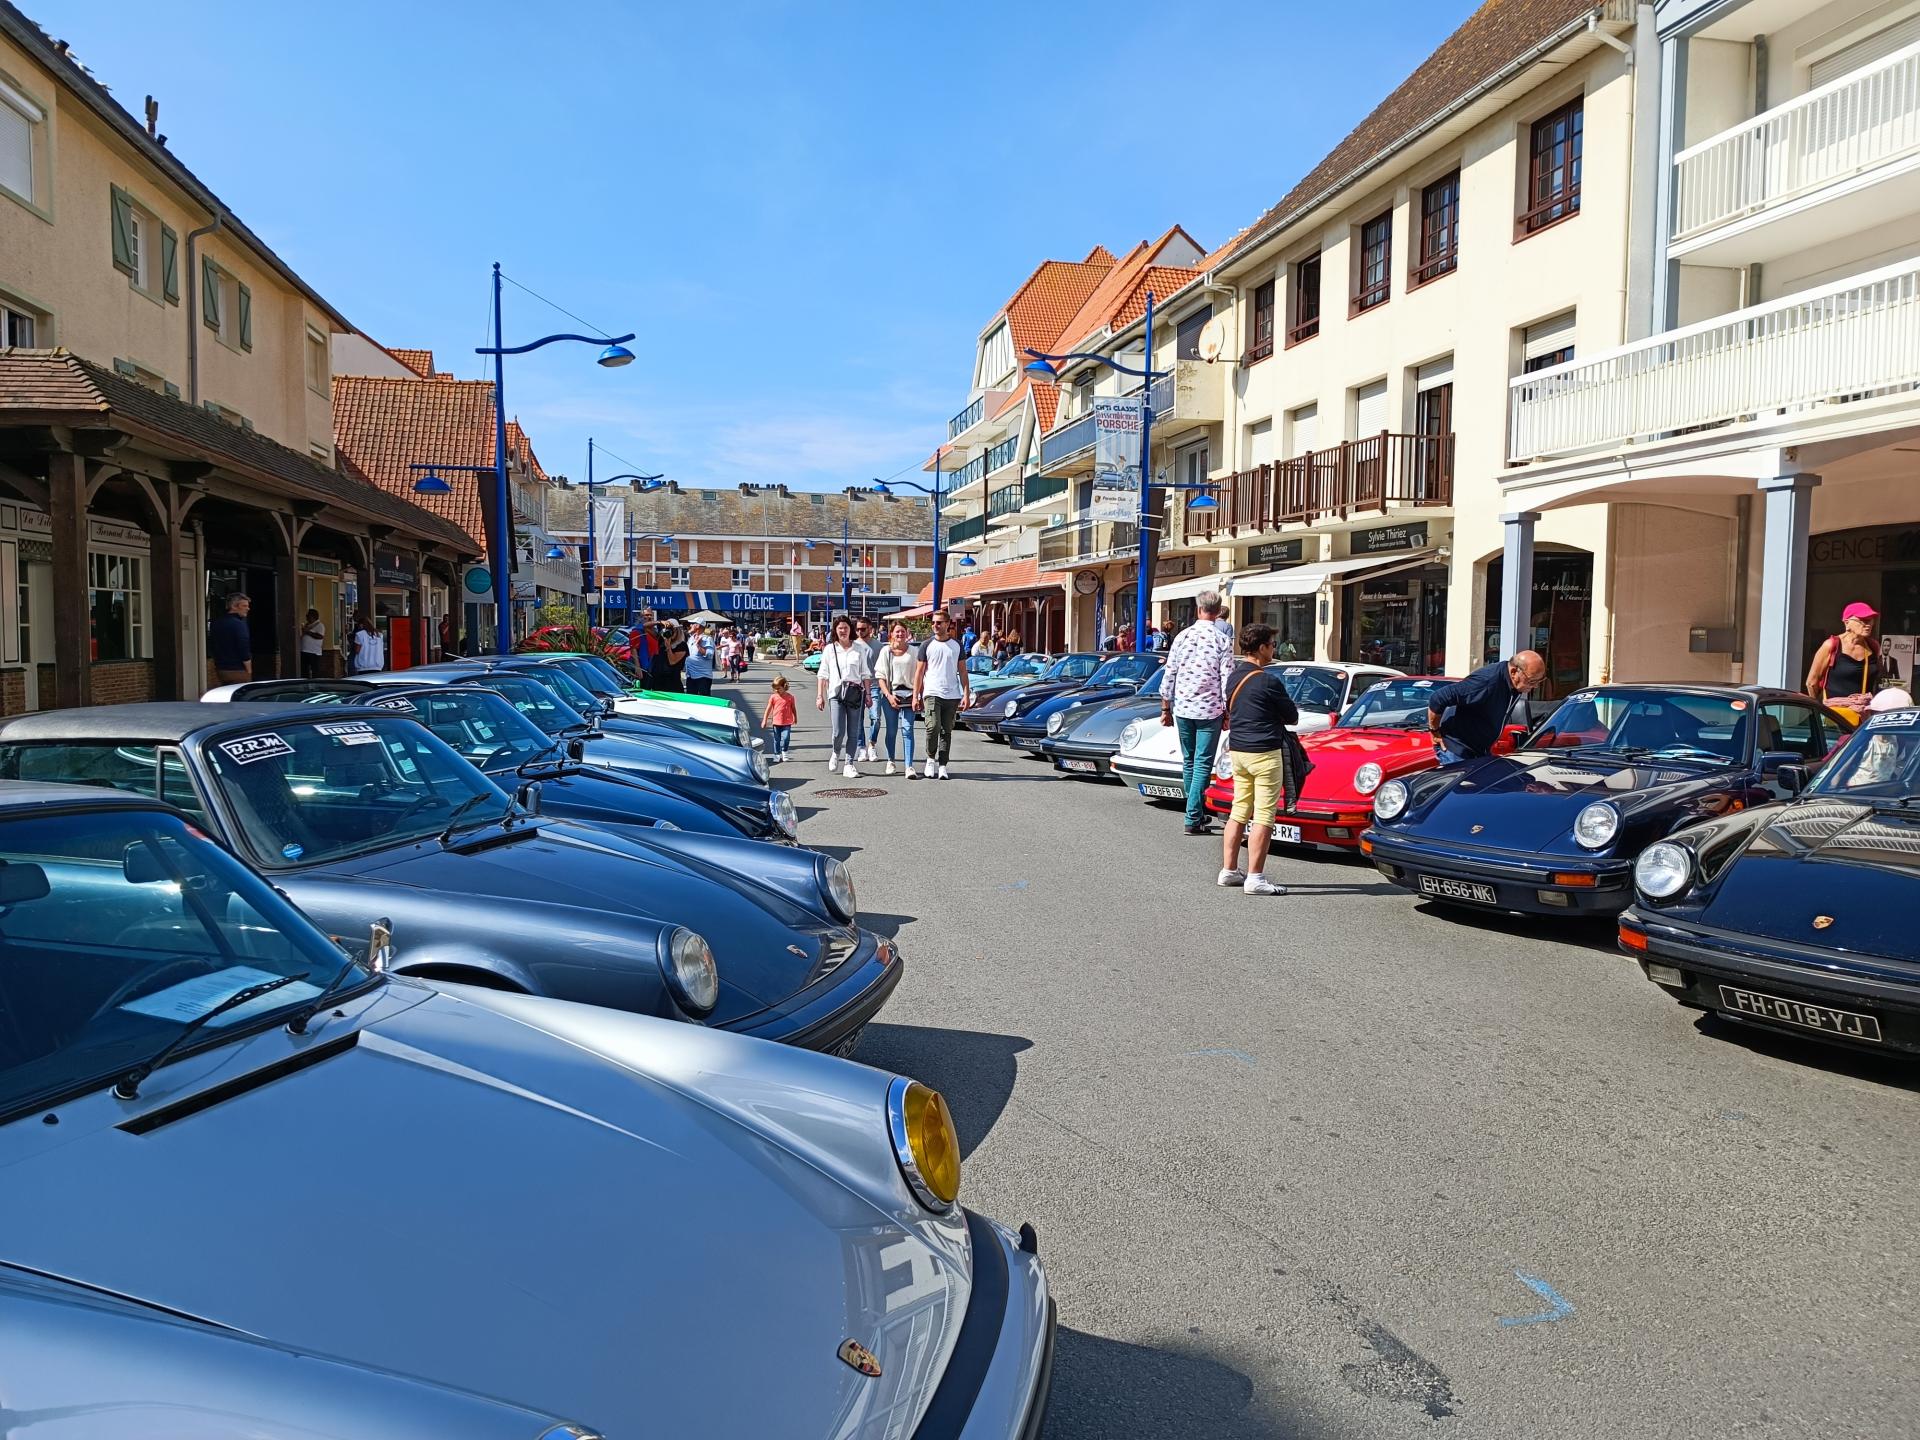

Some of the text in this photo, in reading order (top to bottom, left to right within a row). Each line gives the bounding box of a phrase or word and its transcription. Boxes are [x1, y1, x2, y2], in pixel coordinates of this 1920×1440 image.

[1096, 419, 1139, 430] PORSCHE
[1368, 528, 1407, 545] Sylvie Thiriez
[1260, 546, 1273, 558] Sylvie
[603, 595, 673, 605] RESRANT
[744, 593, 775, 610] DÉLICE
[313, 721, 375, 736] PIRELLI
[1143, 785, 1157, 795] 739
[1158, 786, 1171, 796] BFB
